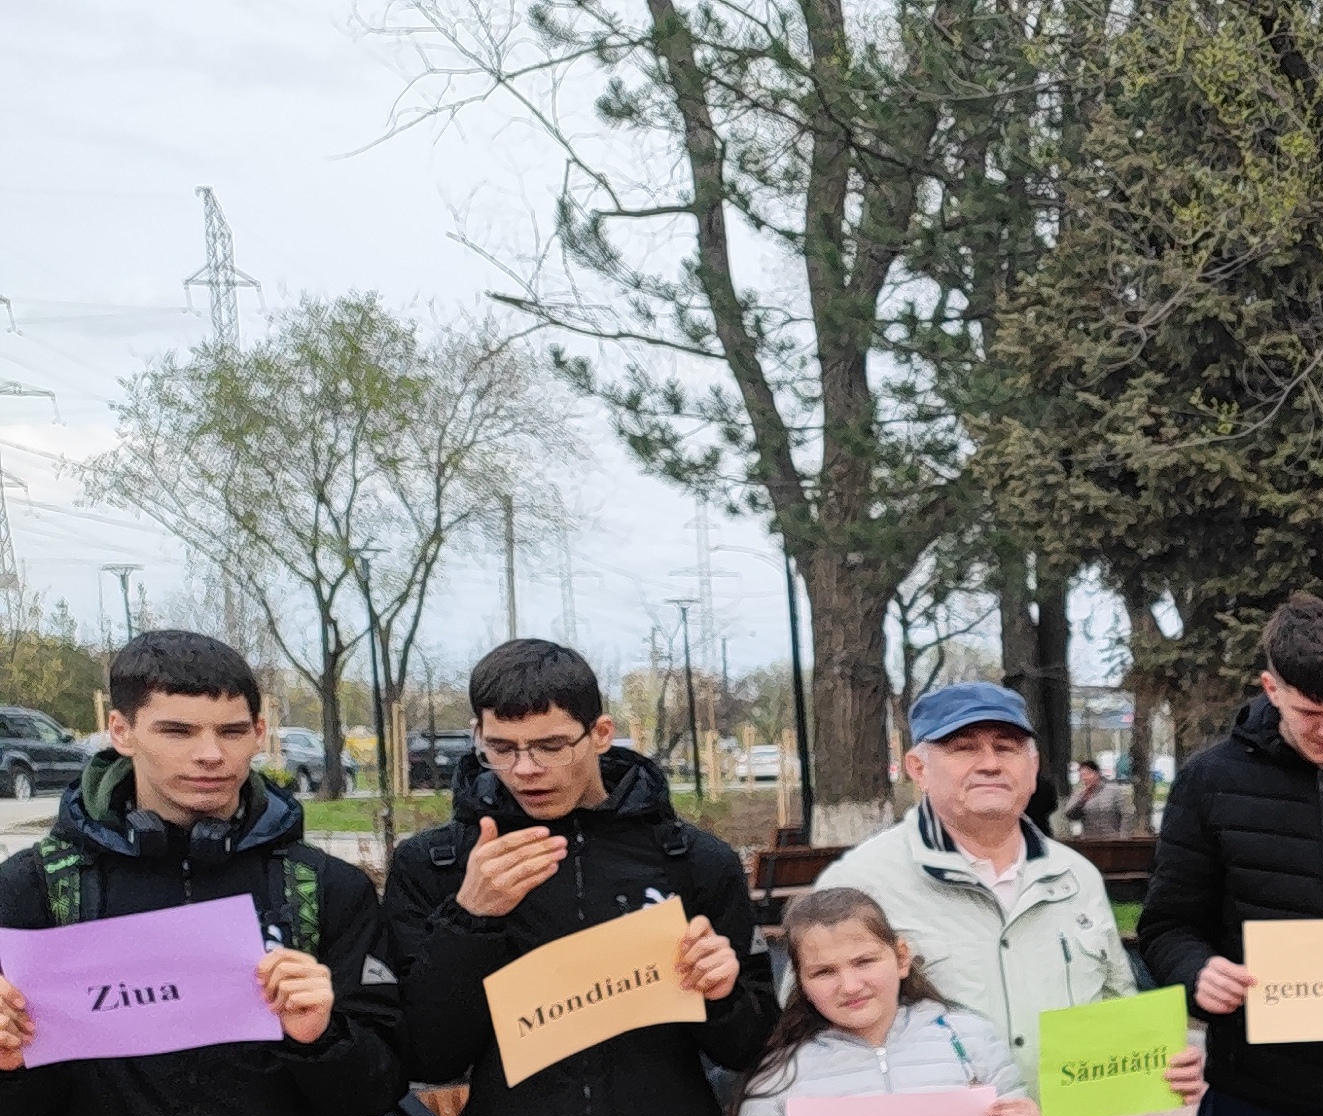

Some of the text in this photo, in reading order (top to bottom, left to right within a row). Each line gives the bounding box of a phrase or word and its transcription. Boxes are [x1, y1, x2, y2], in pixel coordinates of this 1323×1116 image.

[86, 981, 181, 1013] Ziua
[517, 962, 662, 1038] Mondială
[1060, 1045, 1168, 1087] Sănătății
